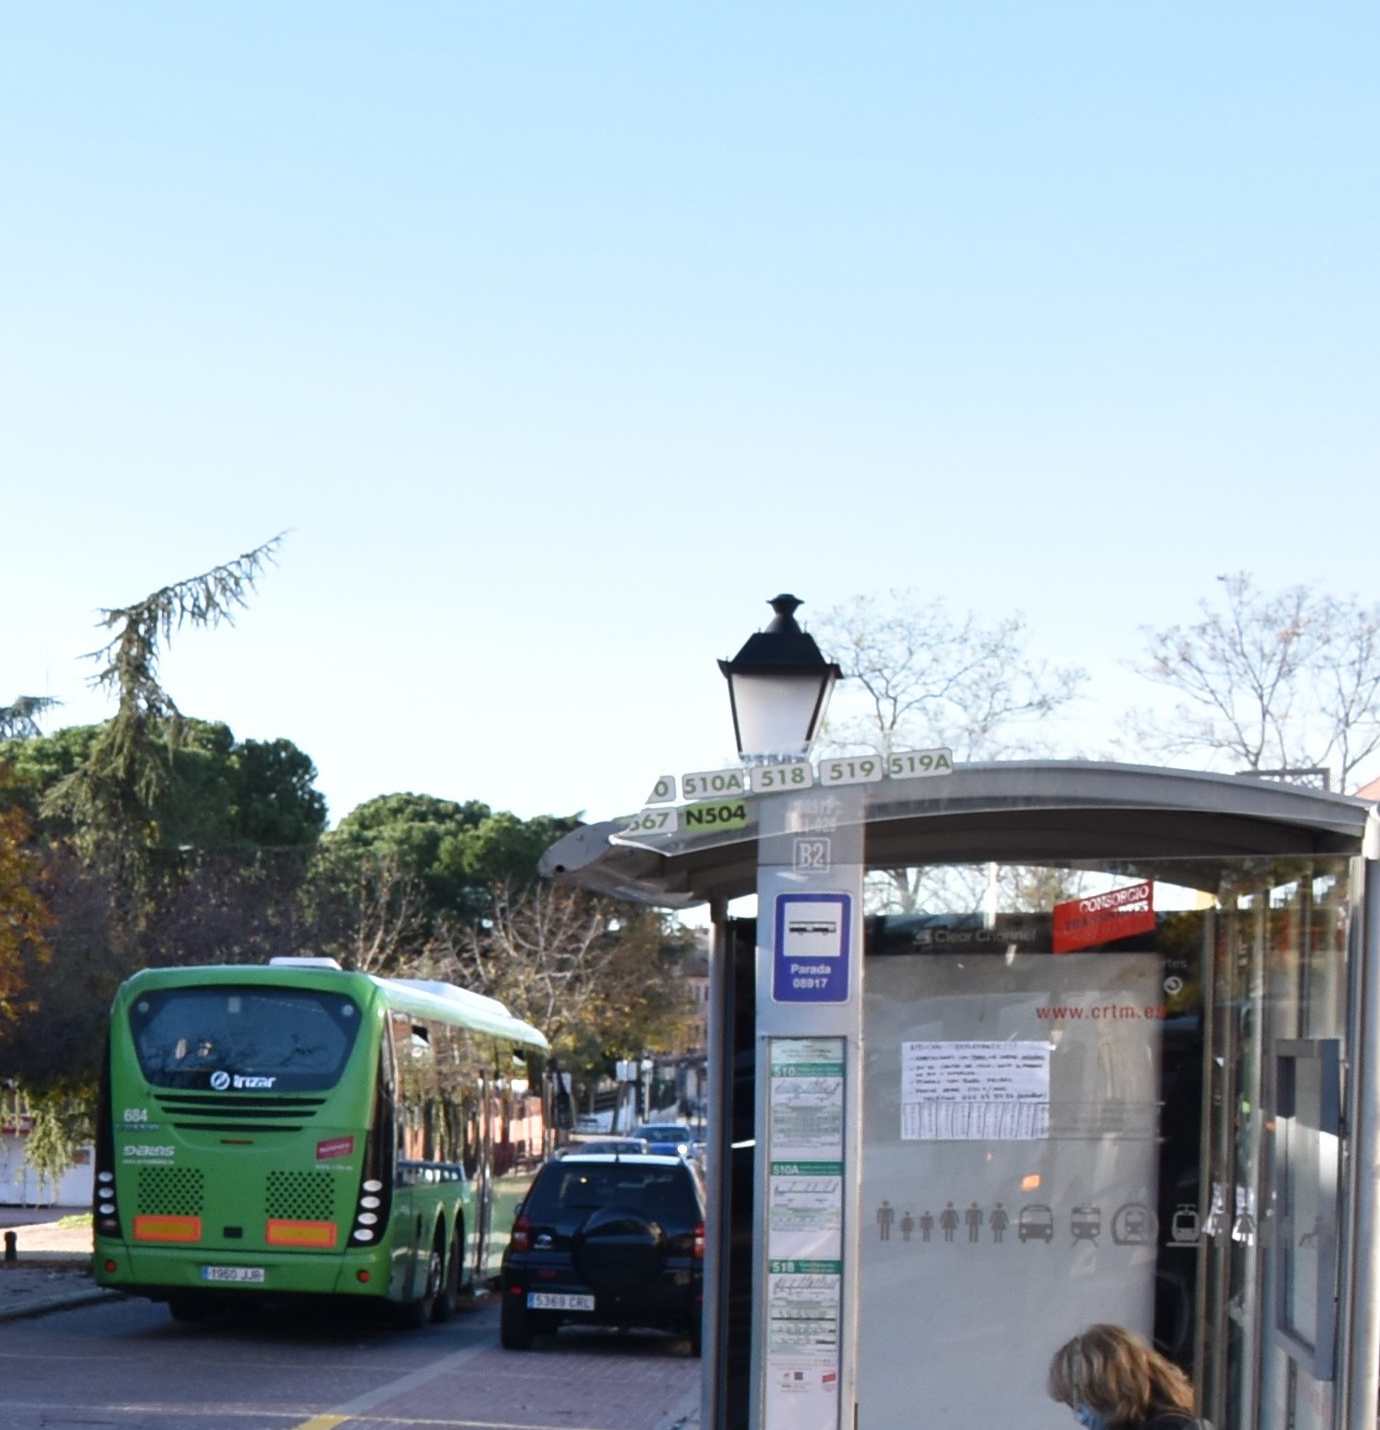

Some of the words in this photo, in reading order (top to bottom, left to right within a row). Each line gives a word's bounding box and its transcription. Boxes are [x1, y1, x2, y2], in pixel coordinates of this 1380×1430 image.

[683, 774, 742, 796] 510A
[760, 767, 805, 788] 518
[829, 760, 876, 781] 519
[890, 753, 951, 775] 519A
[685, 804, 746, 827] N504
[798, 842, 825, 869] B2
[790, 963, 832, 976] Parada
[792, 978, 828, 990] 08917
[1035, 1004, 1167, 1020] www.crtm.es
[123, 1108, 148, 1122] 684
